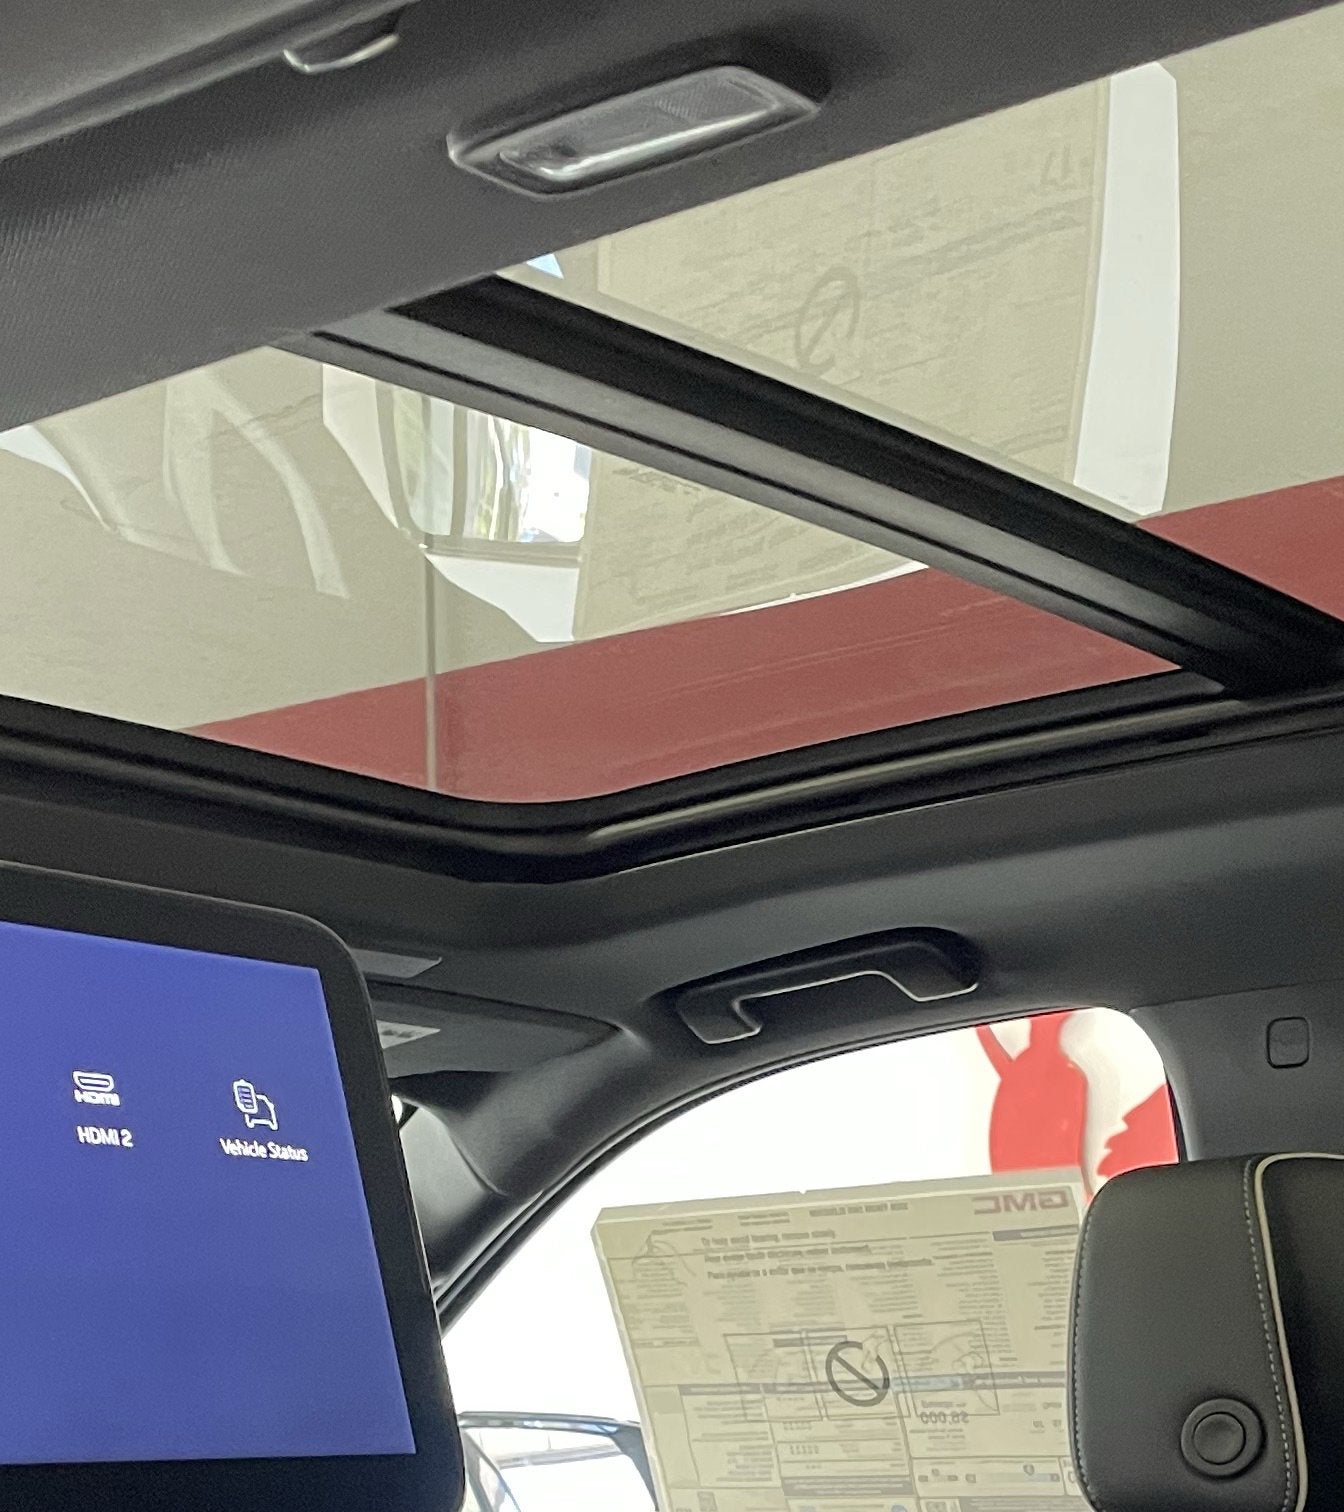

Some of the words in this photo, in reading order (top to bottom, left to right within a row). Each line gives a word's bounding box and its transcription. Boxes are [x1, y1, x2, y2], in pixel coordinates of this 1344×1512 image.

[77, 1126, 120, 1146] HDMI
[121, 1130, 134, 1148] 2
[219, 1138, 268, 1159] Vehicle
[268, 1142, 309, 1162] Status
